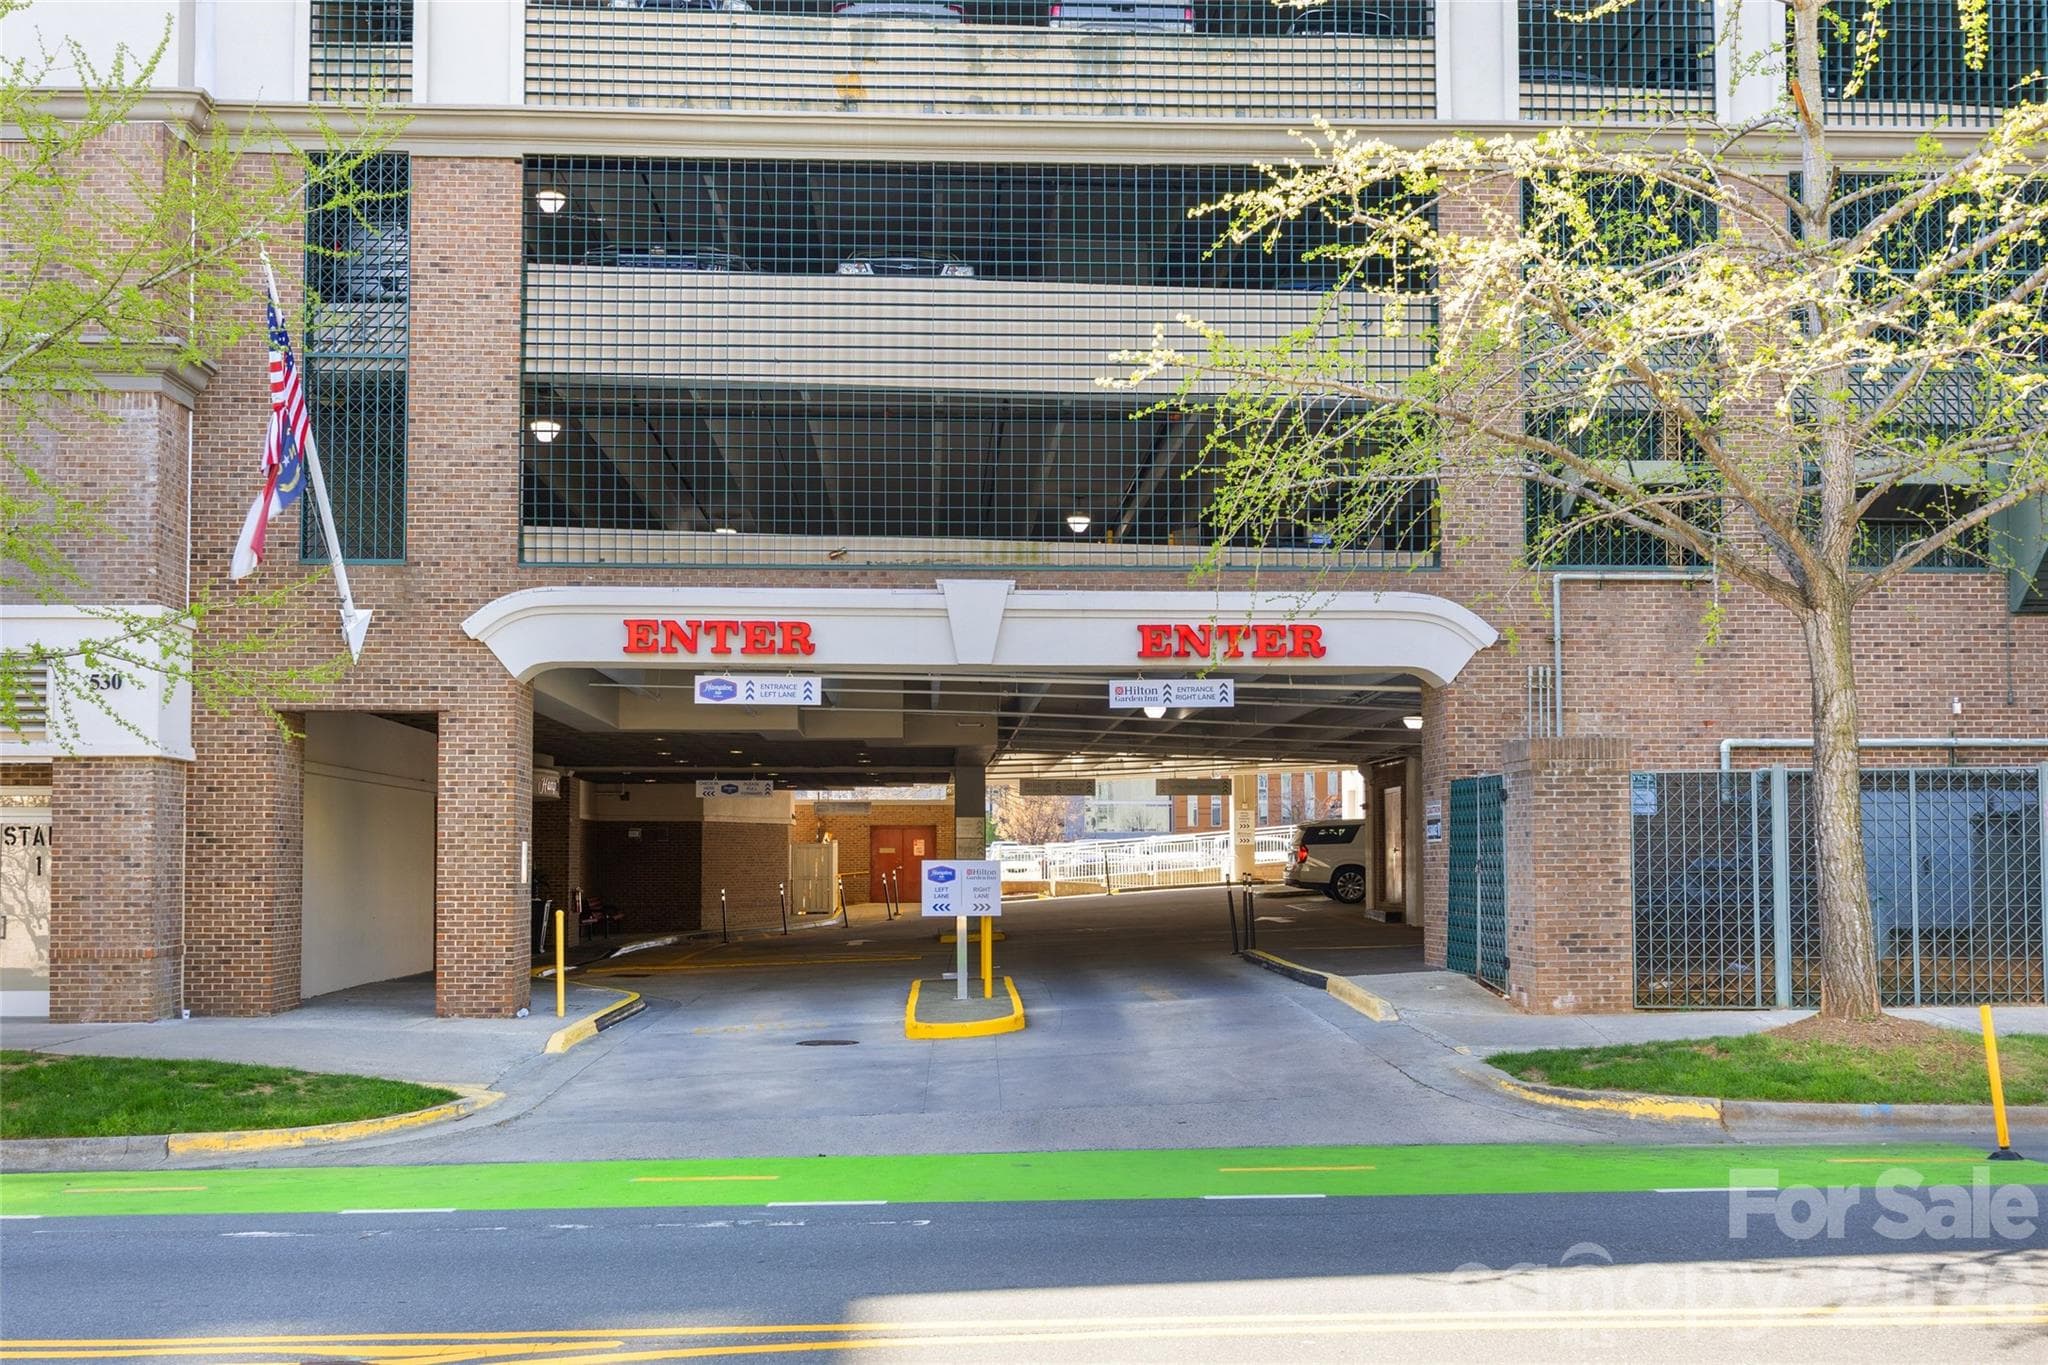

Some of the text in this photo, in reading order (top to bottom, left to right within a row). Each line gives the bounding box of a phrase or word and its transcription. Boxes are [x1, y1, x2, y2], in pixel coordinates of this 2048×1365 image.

[623, 619, 816, 656] ENTER
[1137, 624, 1327, 658] ENTER
[90, 674, 122, 690] 530
[760, 683, 797, 691] ENTRANCE
[1125, 686, 1158, 695] Hilton
[1175, 693, 1196, 701] RIGHT
[36, 856, 41, 876] 1
